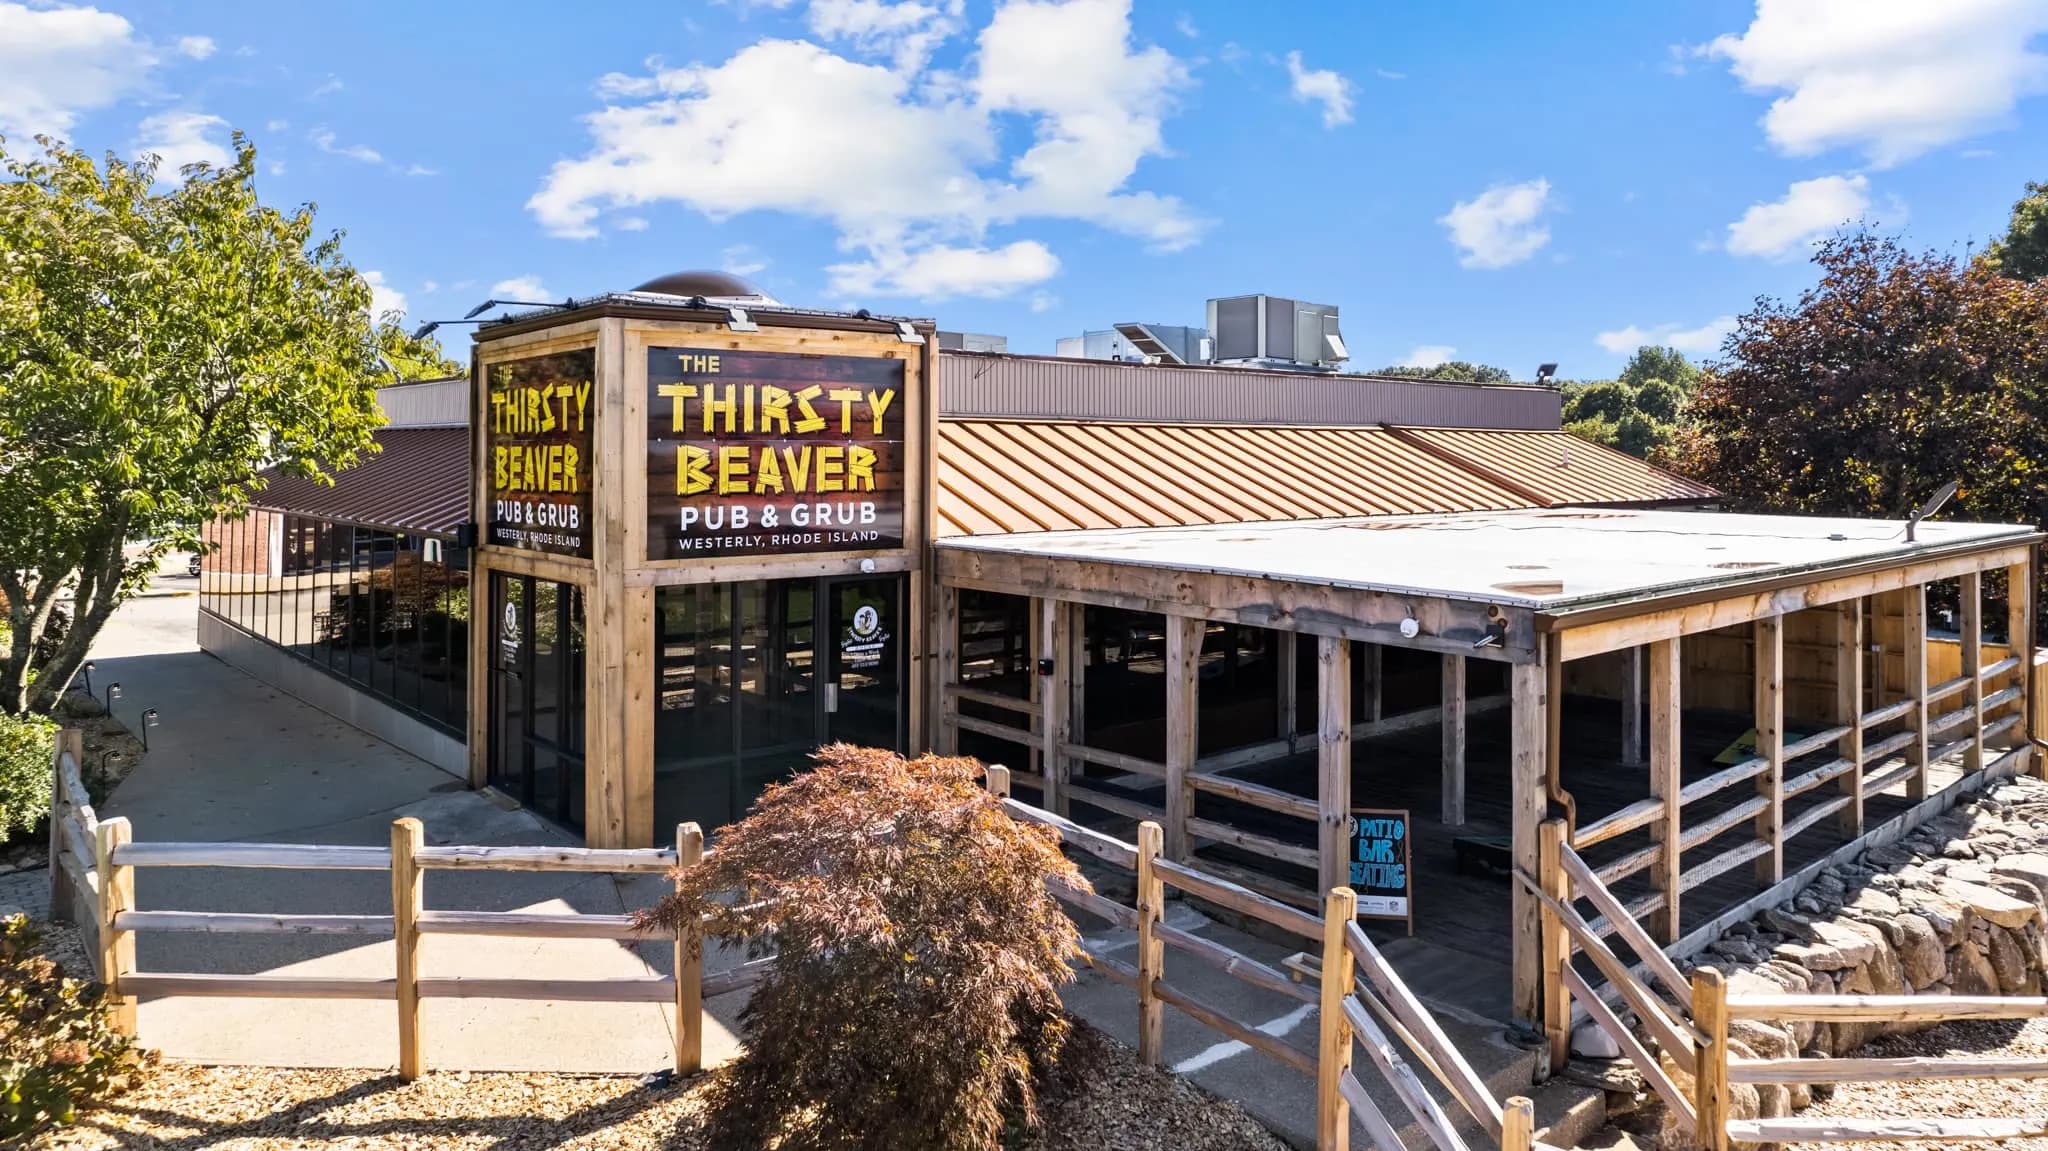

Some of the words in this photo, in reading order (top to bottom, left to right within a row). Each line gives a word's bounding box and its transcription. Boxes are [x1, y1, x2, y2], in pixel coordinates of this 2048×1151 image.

[678, 354, 720, 373] THE
[491, 380, 591, 434] THIRSTY
[657, 382, 896, 435] THIRSTY
[496, 443, 579, 493] BEAVER
[676, 445, 878, 496] BEAVER
[496, 500, 522, 523] PUB
[525, 502, 534, 524] &
[537, 503, 579, 529] GRUB
[680, 504, 750, 531] PUB
[760, 504, 779, 528] &
[790, 501, 878, 527] GRUB
[496, 528, 529, 543] WESTERLY,
[530, 531, 553, 545] RHODE
[554, 534, 581, 548] ISLAND
[679, 535, 766, 549] WESTERLY,
[771, 532, 822, 546] RHODE
[828, 530, 879, 543] ISLAND
[1360, 818, 1405, 840] PATIO
[1359, 839, 1394, 863] BAR
